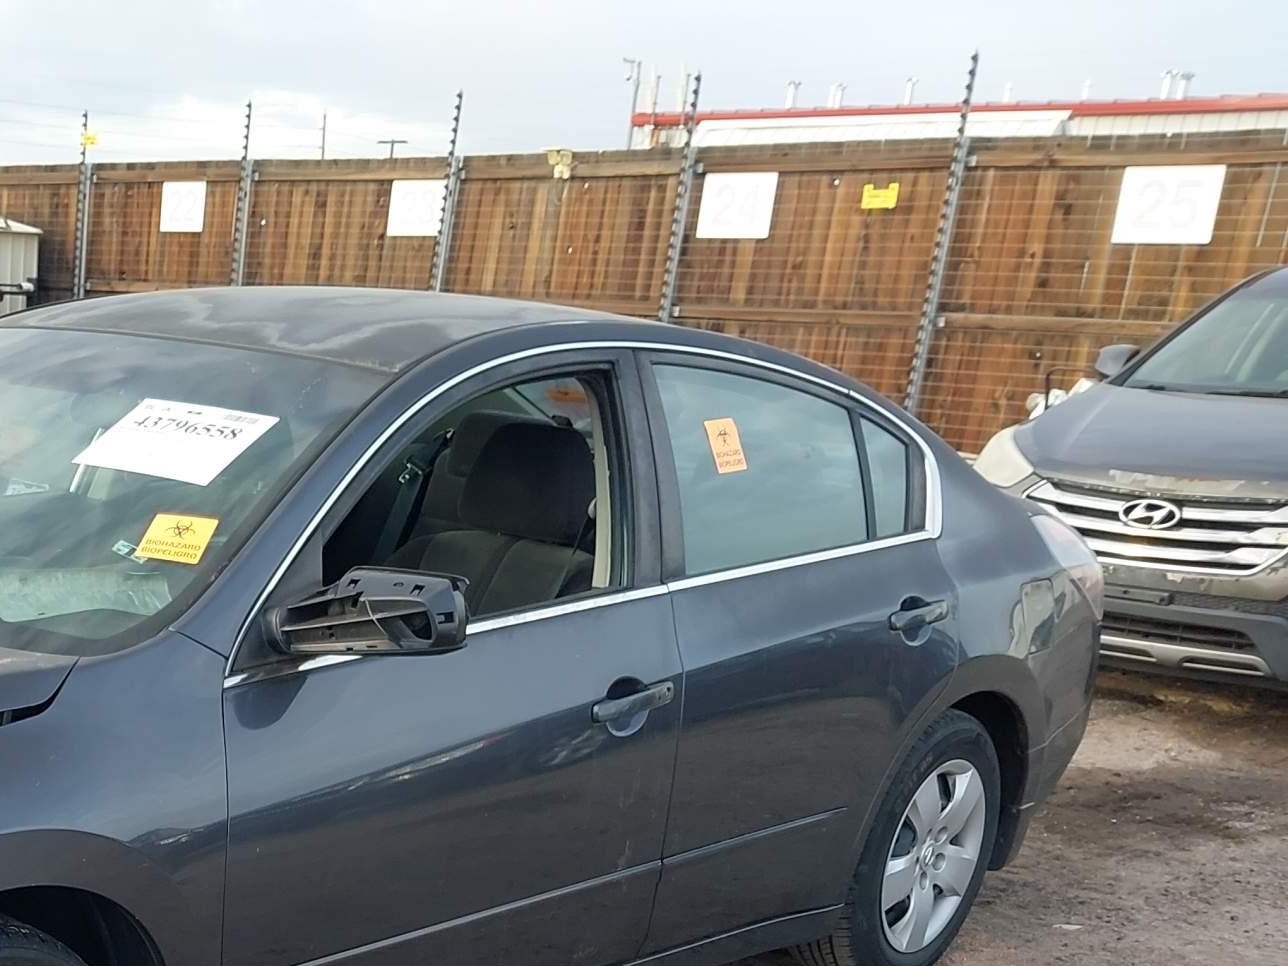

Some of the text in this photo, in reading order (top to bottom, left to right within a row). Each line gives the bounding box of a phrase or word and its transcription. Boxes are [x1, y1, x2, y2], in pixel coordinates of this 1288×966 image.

[711, 182, 761, 225] 24
[1131, 178, 1204, 230] 25
[133, 414, 244, 441] 43796558
[140, 546, 198, 560] BIOPELIGRO
[144, 537, 201, 552] BIOHAZARD
